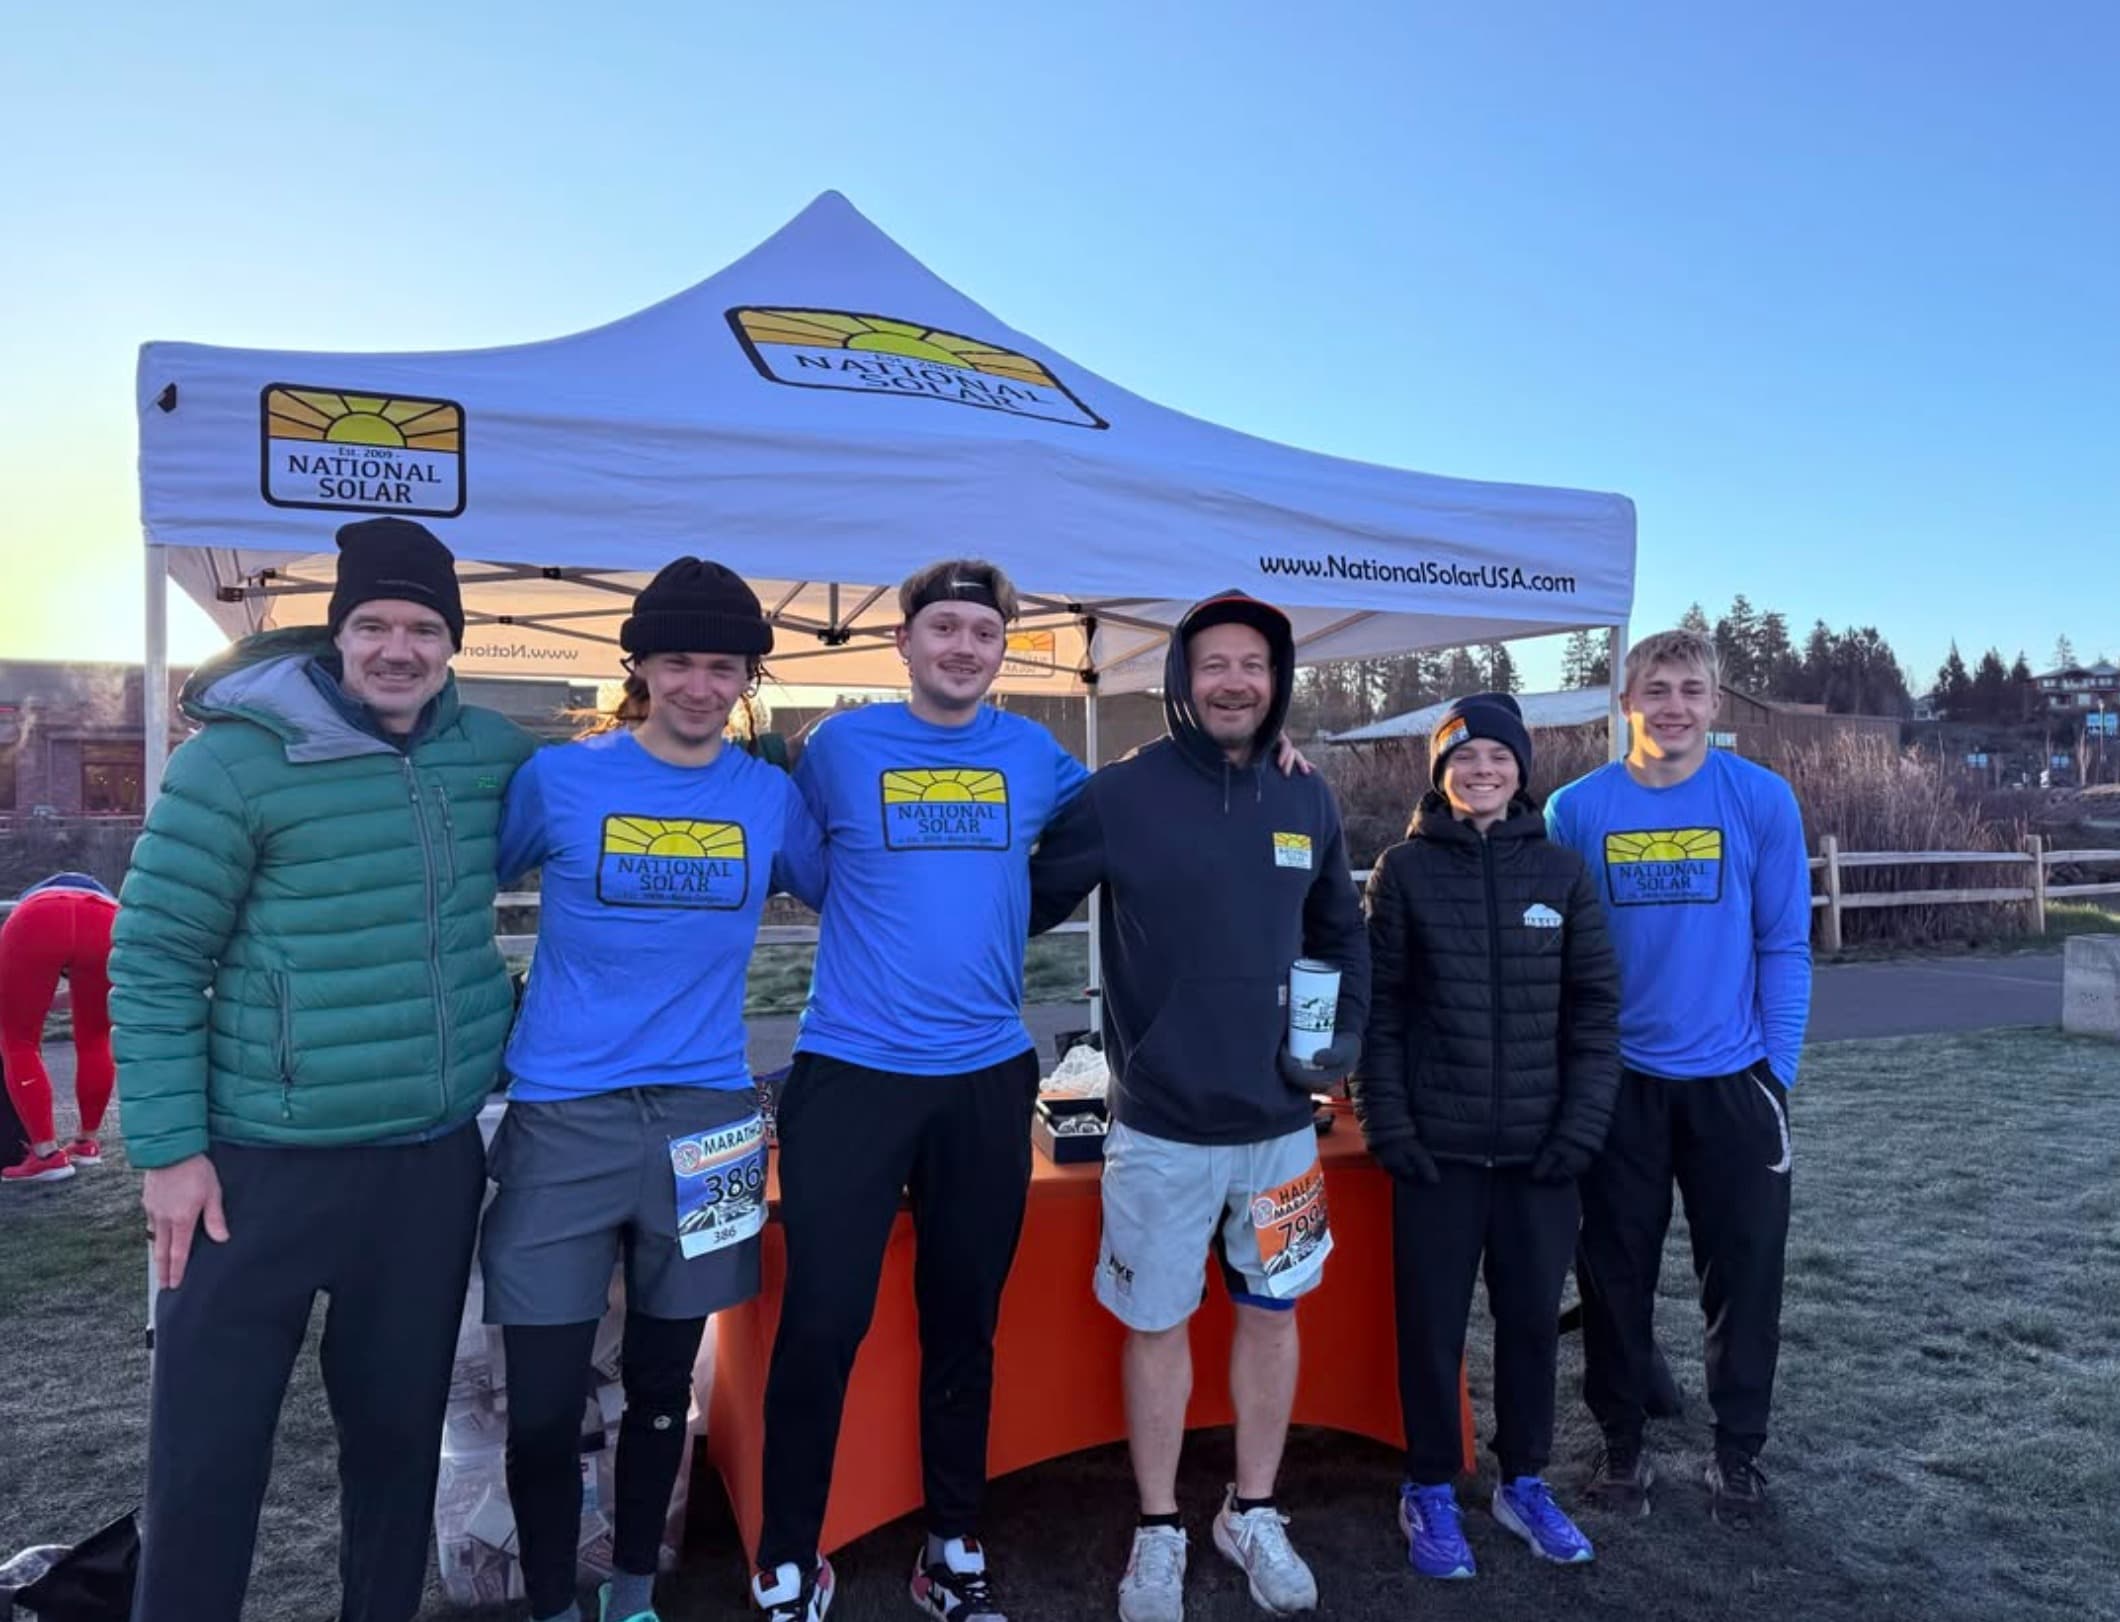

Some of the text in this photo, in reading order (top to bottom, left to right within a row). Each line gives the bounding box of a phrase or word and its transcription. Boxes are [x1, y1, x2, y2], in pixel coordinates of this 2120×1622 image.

[364, 449, 393, 459] 2009
[288, 454, 442, 484] NATIONAL
[319, 477, 413, 503] SOLAR
[1259, 554, 1576, 593] www.NationalSolarUSA.com
[898, 805, 996, 820] NATIONAL
[919, 819, 981, 834] SOLAR
[618, 857, 734, 878] NATIONAL
[1619, 862, 1709, 878] NATIONAL
[640, 874, 709, 893] SOLAR
[1636, 876, 1692, 891] SOLAR
[705, 1158, 762, 1206] 386
[1279, 1178, 1313, 1203] HALF
[713, 1226, 737, 1244] 386
